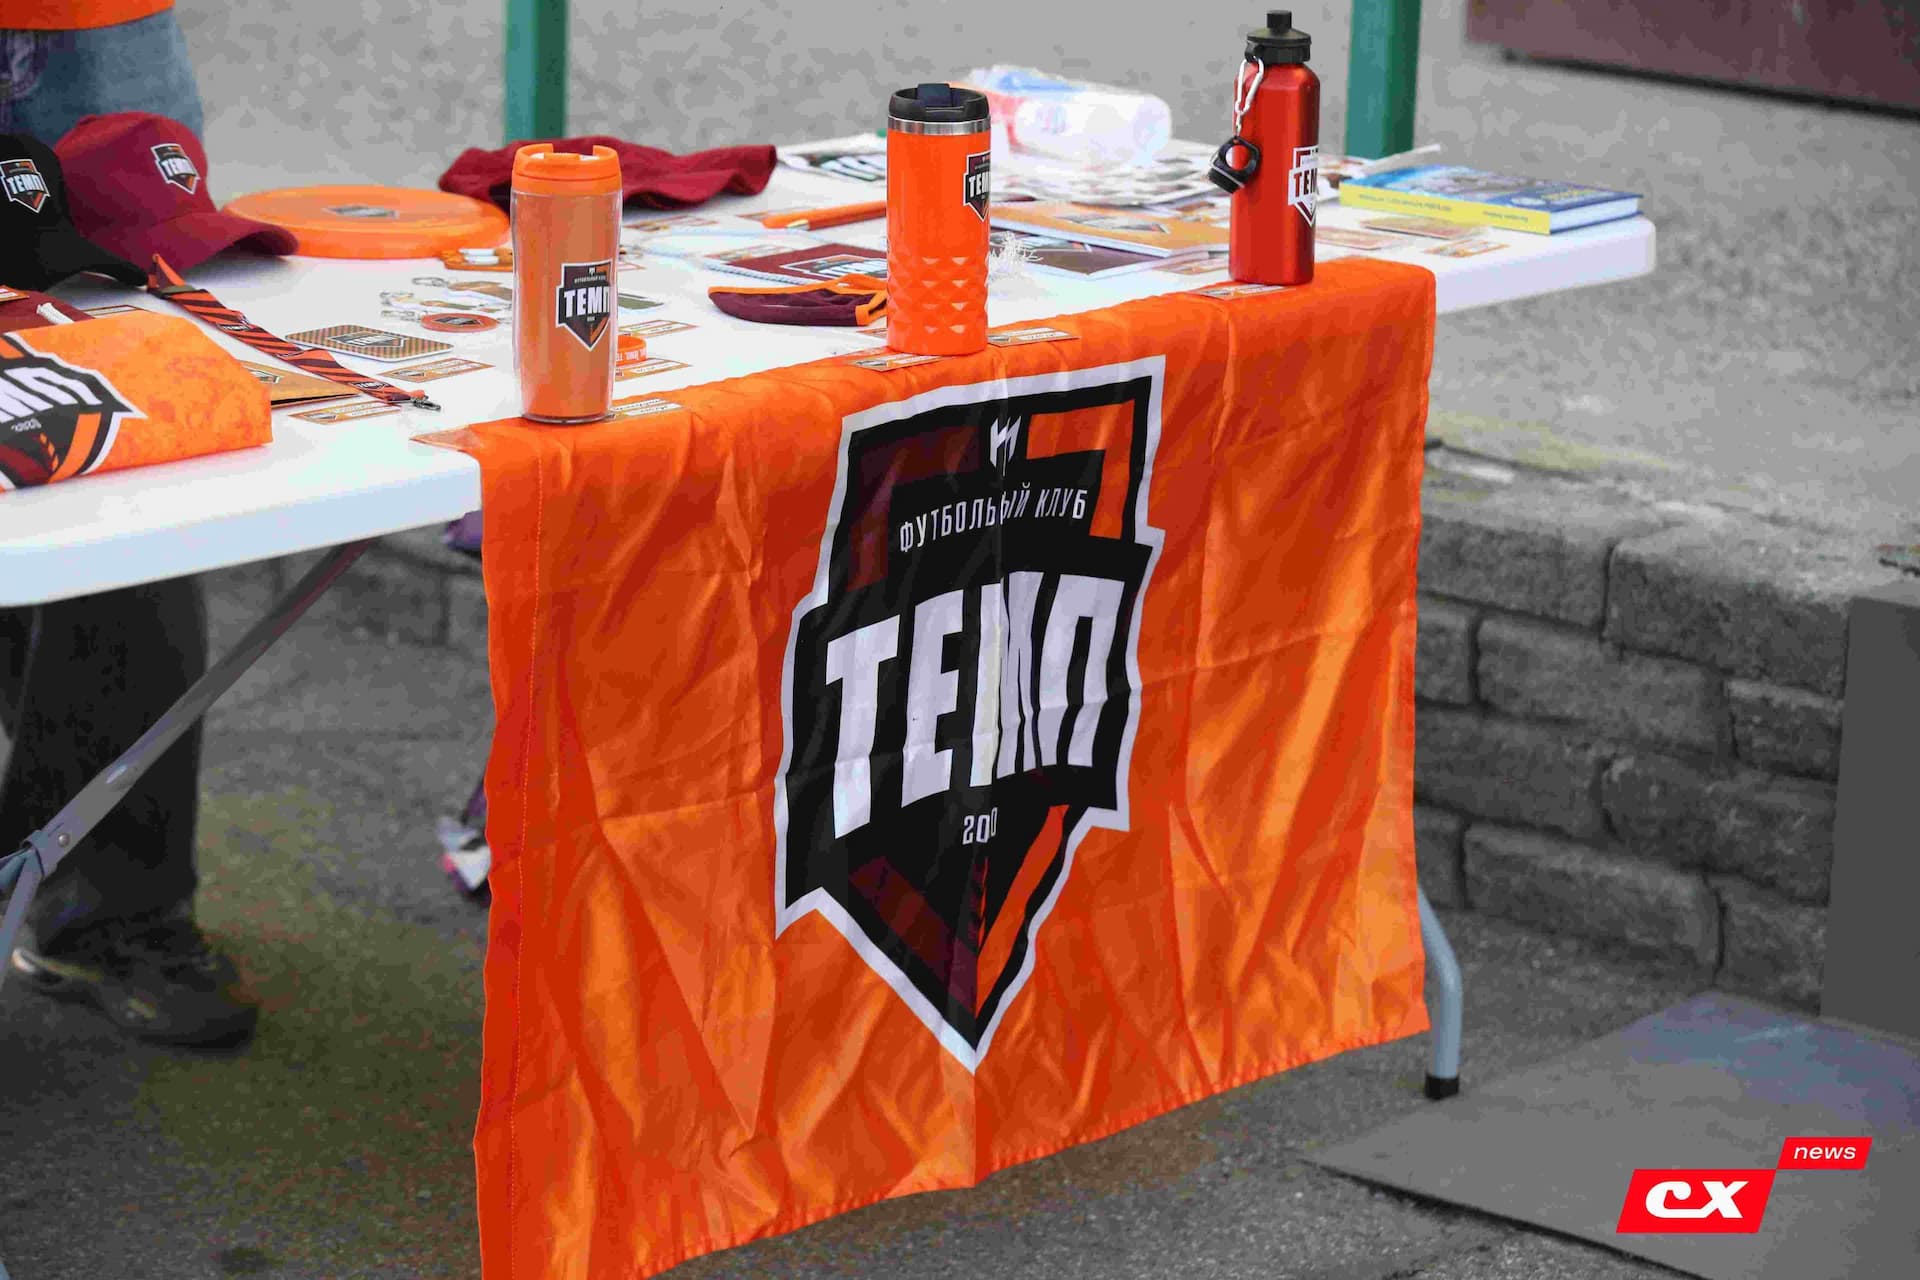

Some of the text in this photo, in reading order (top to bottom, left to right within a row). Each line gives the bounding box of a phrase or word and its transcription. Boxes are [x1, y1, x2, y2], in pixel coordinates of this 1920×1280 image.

[969, 170, 991, 198] ТЕМ
[900, 482, 1088, 552] ФУТБОЛЬЫЙ КЛУБ
[826, 571, 1125, 839] ТЕМП
[962, 807, 998, 845] 200
